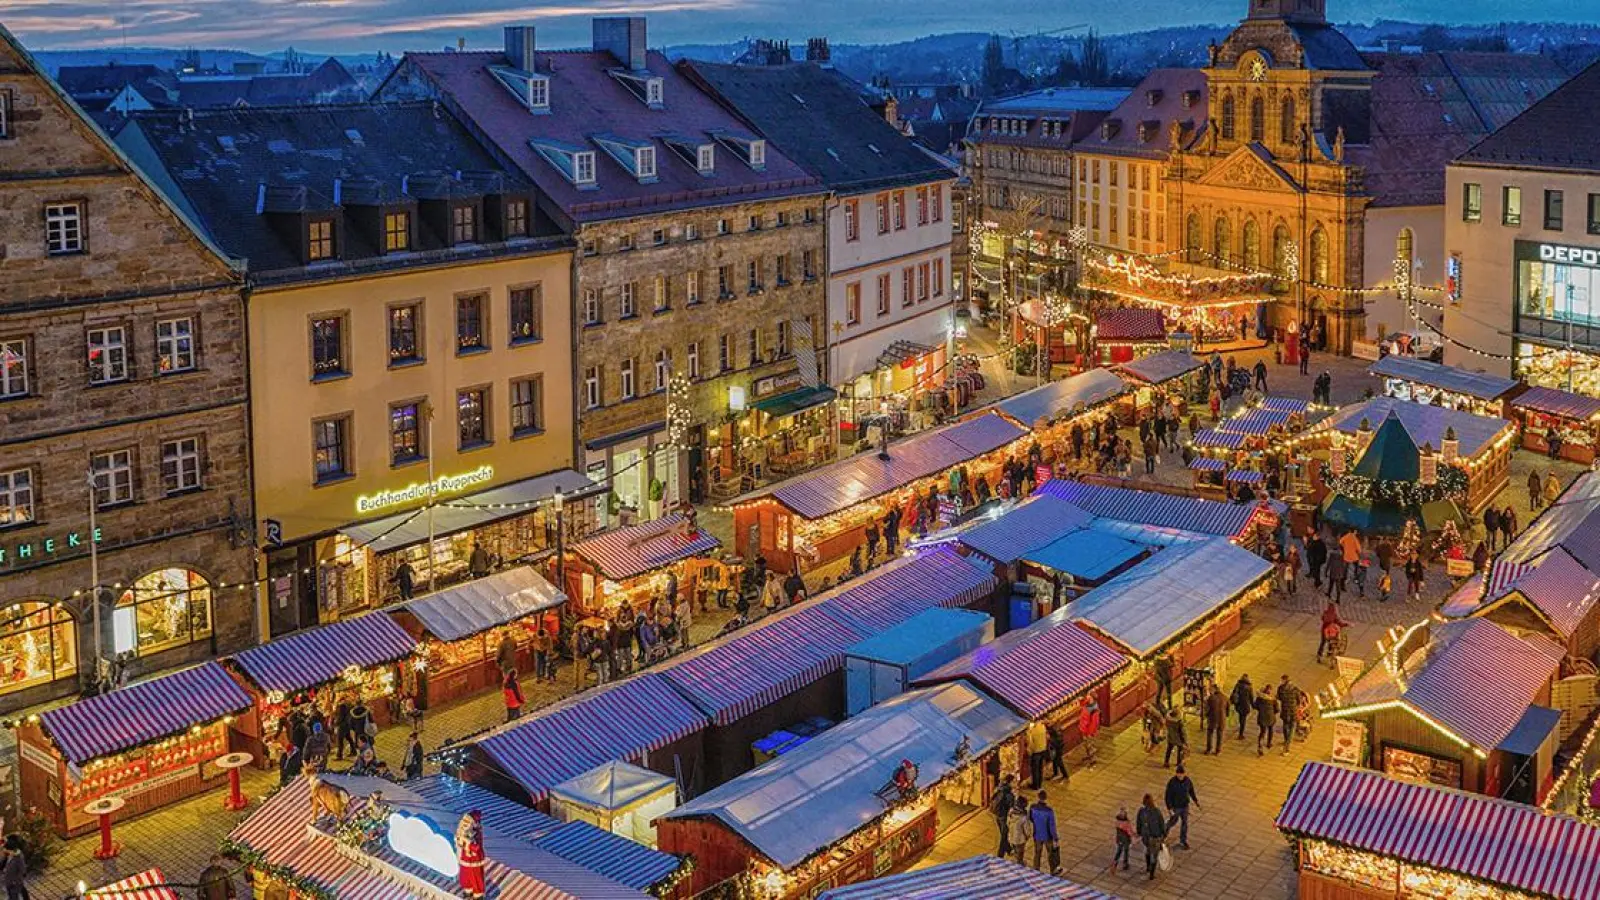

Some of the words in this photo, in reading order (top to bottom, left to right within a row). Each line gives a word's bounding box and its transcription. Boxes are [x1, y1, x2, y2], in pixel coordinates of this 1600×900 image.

[1540, 244, 1600, 264] DEPO
[360, 482, 439, 511] Buchhandlung
[440, 468, 493, 491] Rupprecht
